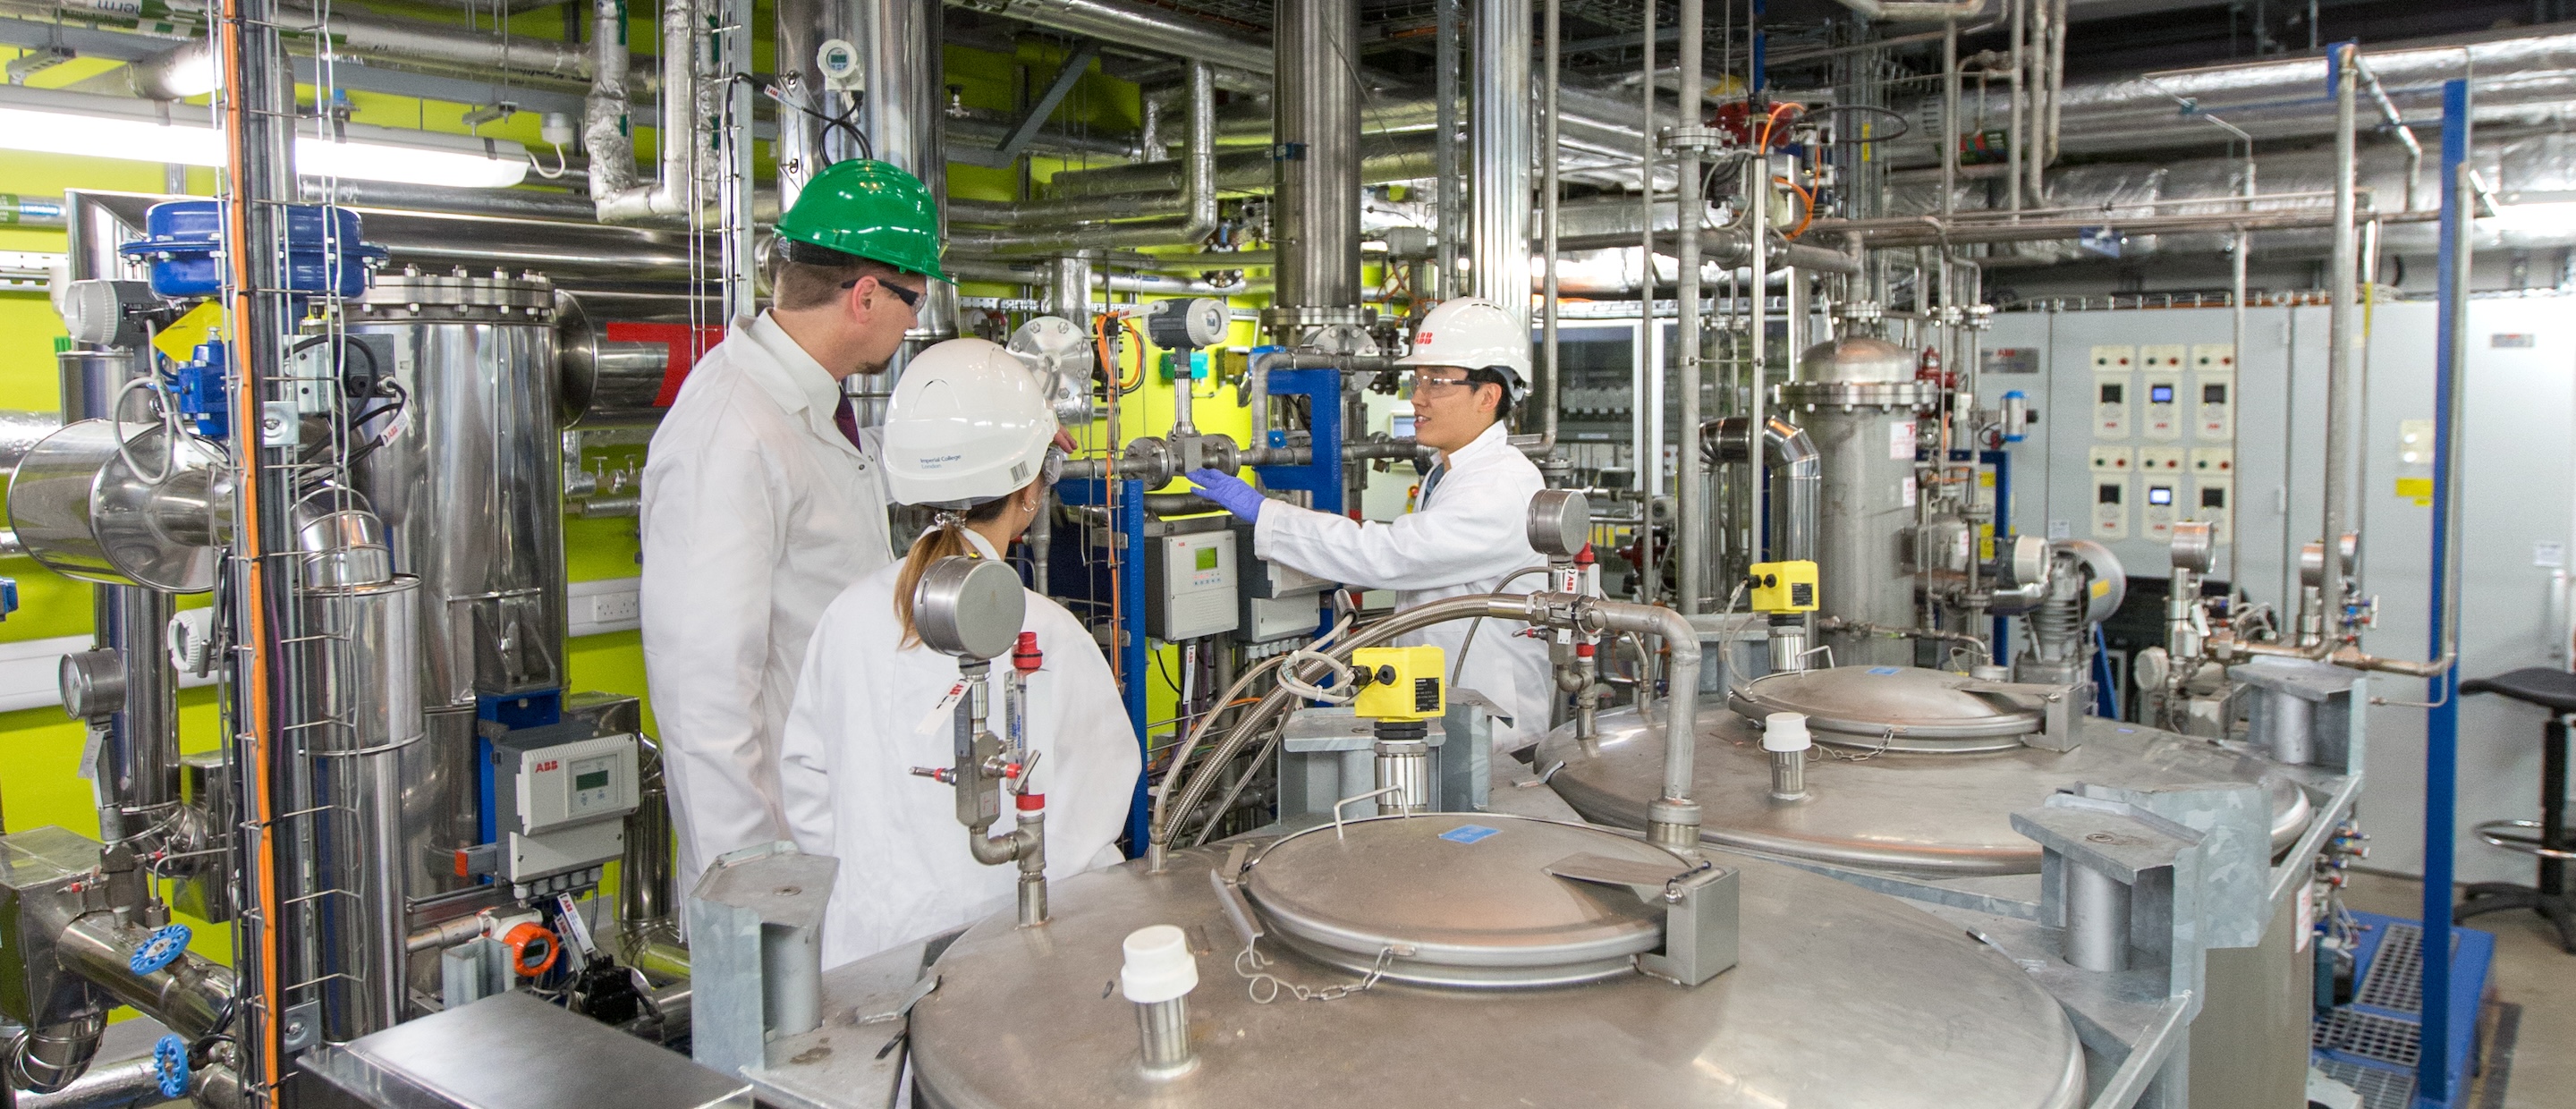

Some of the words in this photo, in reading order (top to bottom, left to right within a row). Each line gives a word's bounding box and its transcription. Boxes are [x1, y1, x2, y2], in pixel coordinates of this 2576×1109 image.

[1416, 332, 1433, 344] ABB
[941, 454, 962, 462] College
[1566, 575, 1574, 591] ABB
[949, 683, 964, 696] ABB
[535, 760, 559, 774] ABB
[562, 900, 573, 912] ABB
[558, 921, 568, 935] ABB
